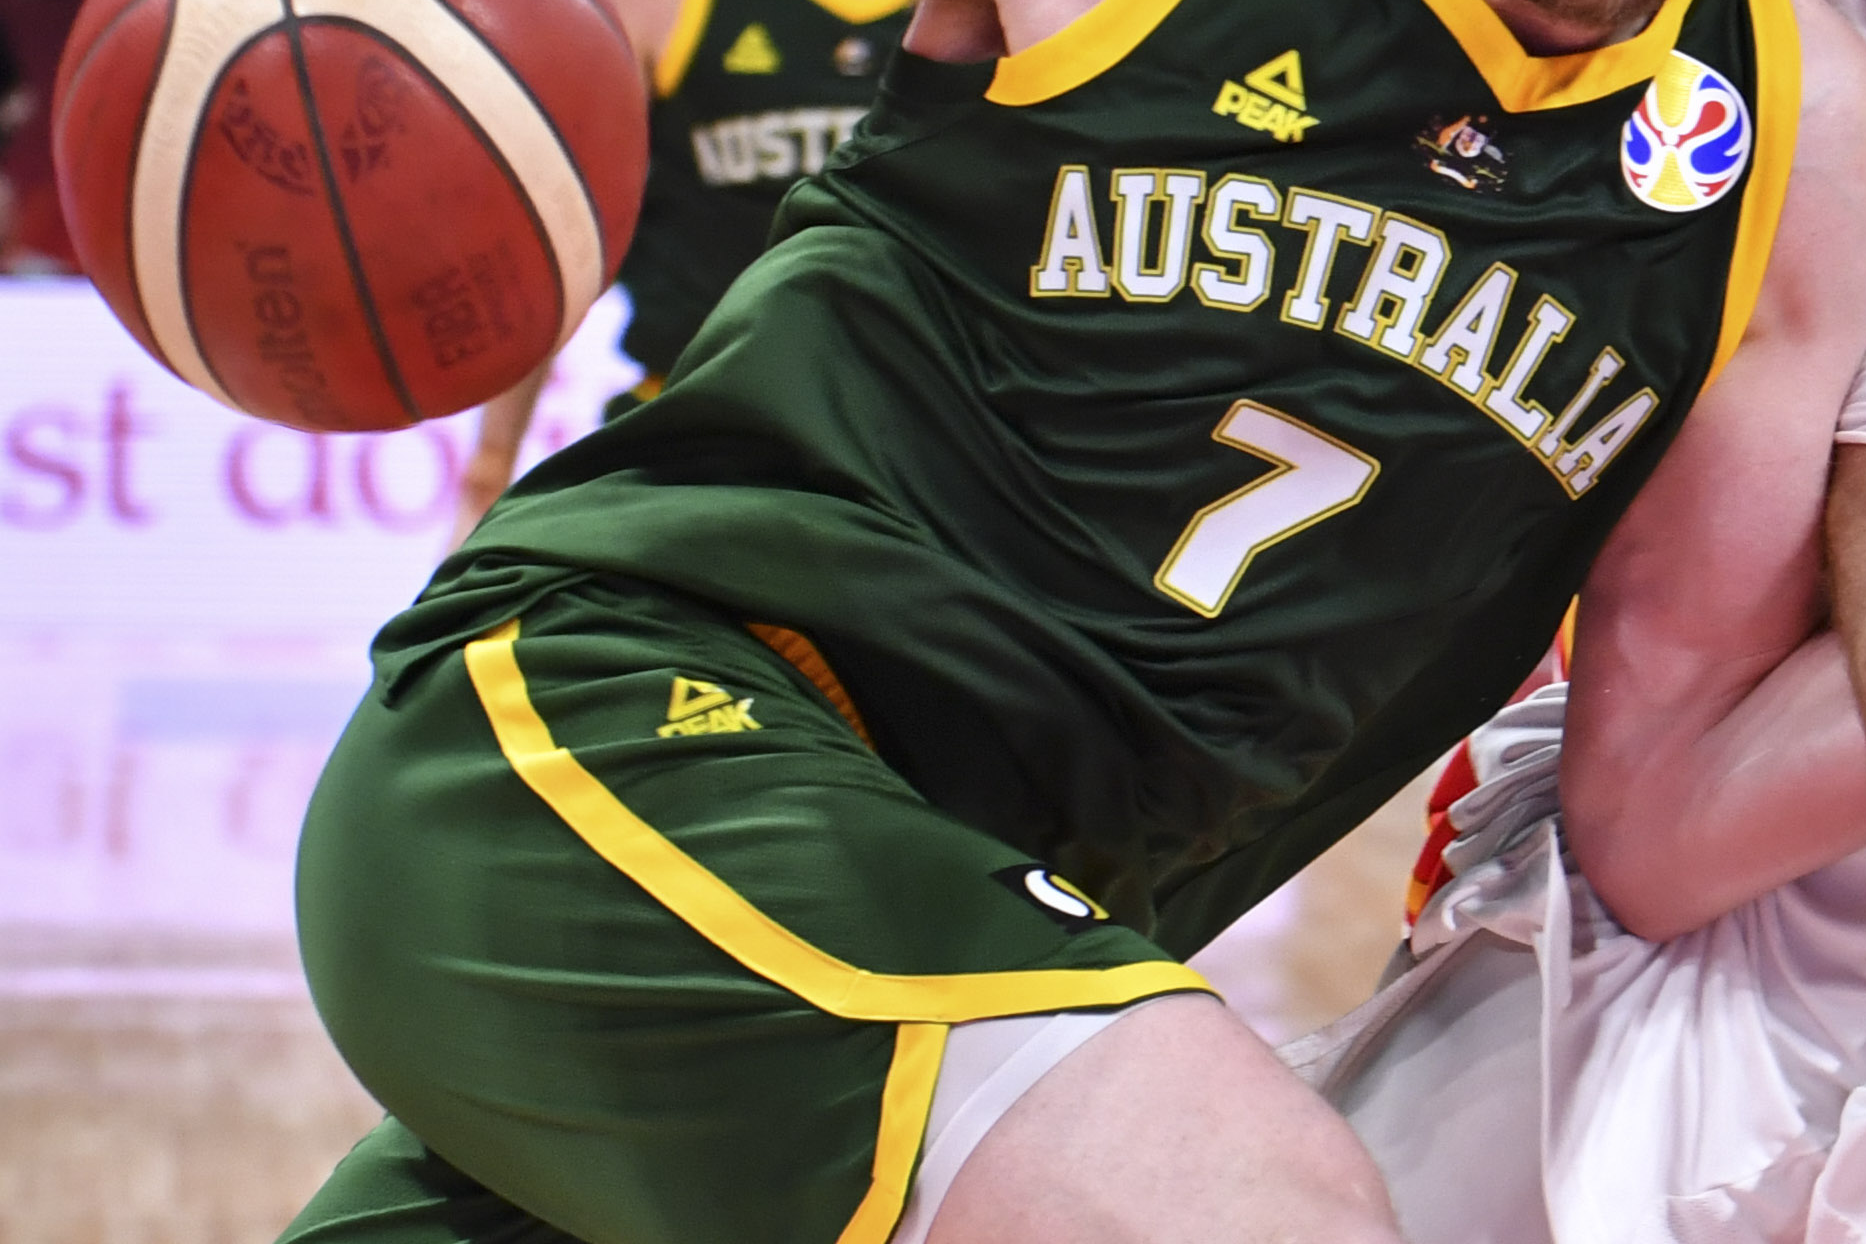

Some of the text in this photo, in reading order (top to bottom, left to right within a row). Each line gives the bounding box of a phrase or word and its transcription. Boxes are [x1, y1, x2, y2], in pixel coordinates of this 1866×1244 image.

[1211, 79, 1321, 143] PEAK
[1030, 164, 1660, 500] AUSTRALIA
[1154, 399, 1381, 618] 7
